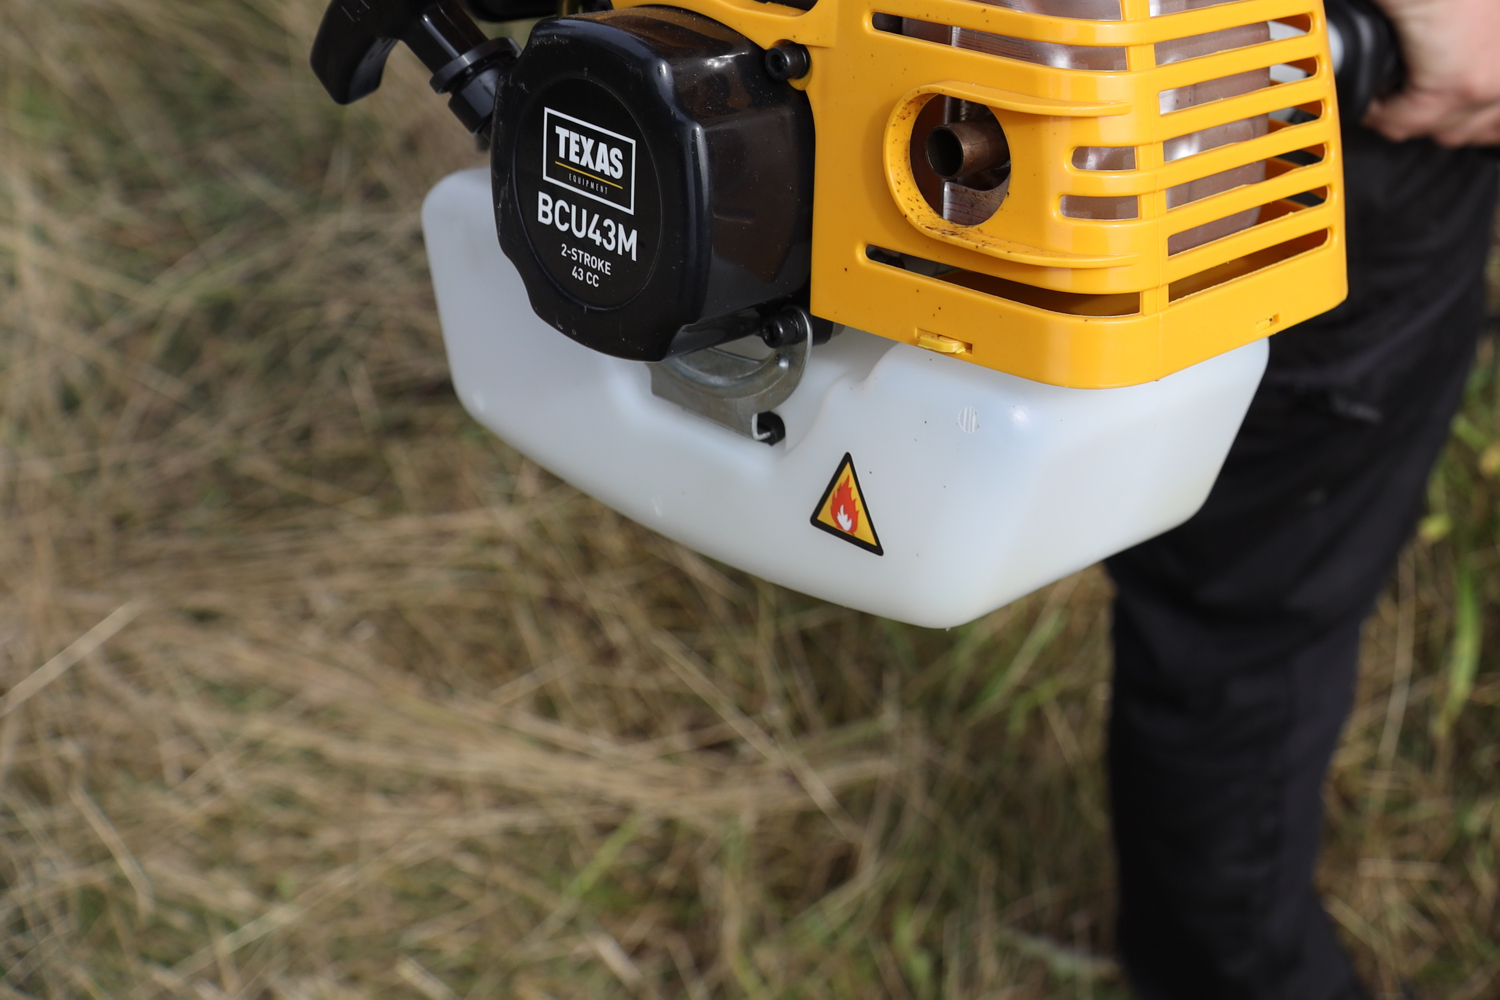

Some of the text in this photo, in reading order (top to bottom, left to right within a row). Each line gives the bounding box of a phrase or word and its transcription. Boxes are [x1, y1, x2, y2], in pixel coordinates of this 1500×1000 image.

[555, 125, 624, 180] TEXAS
[568, 173, 609, 195] EQUIPMENT
[538, 191, 638, 262] BCU43M
[561, 243, 612, 276] 2-STROKE
[571, 266, 600, 288] 43 CC
